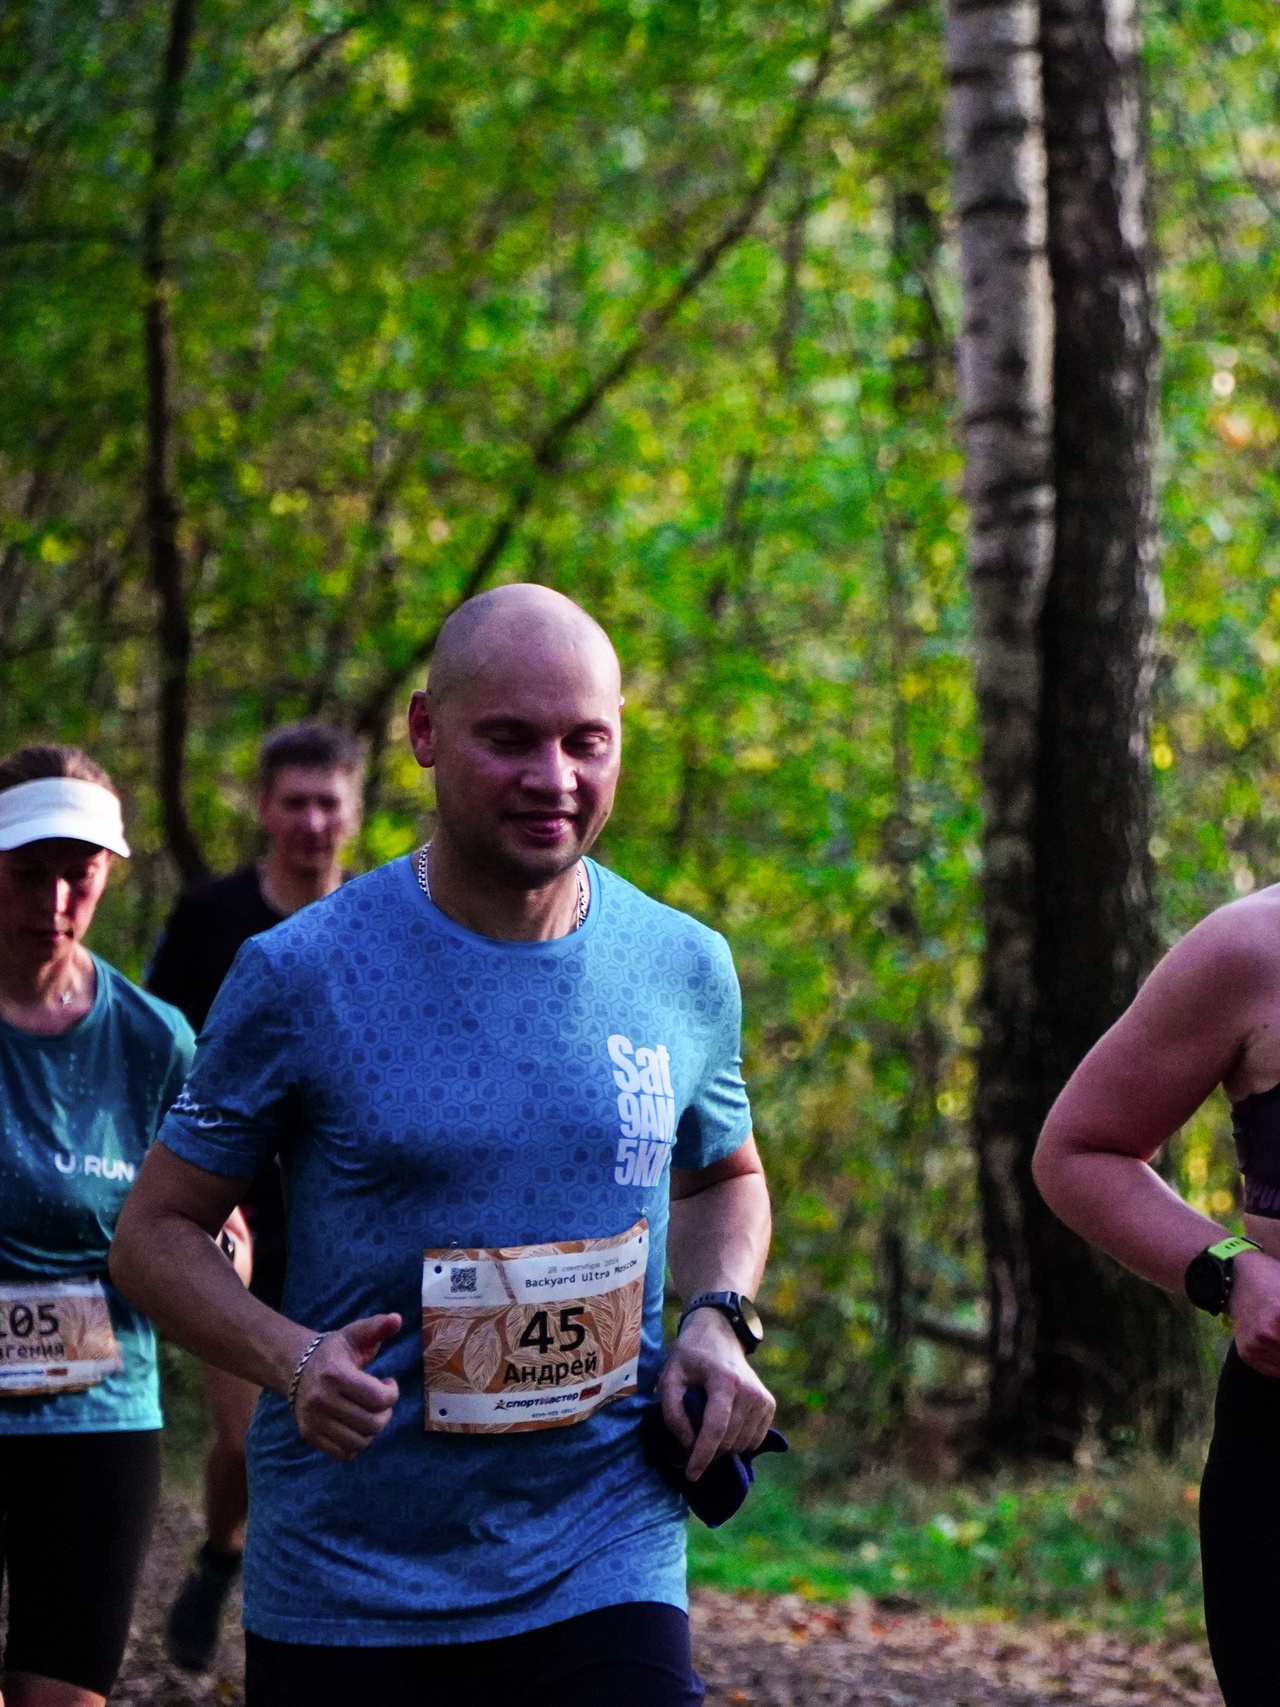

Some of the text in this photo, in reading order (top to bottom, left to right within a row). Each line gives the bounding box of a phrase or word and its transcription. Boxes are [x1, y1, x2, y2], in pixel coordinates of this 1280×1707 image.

[606, 1034, 675, 1098] Sat
[84, 1154, 136, 1183] RUN
[525, 1259, 638, 1289] Backyard Ultra Moscow
[0, 1303, 60, 1338] 05
[519, 1306, 586, 1354] 45
[0, 1343, 66, 1360] гения
[502, 1352, 597, 1386] Андрей
